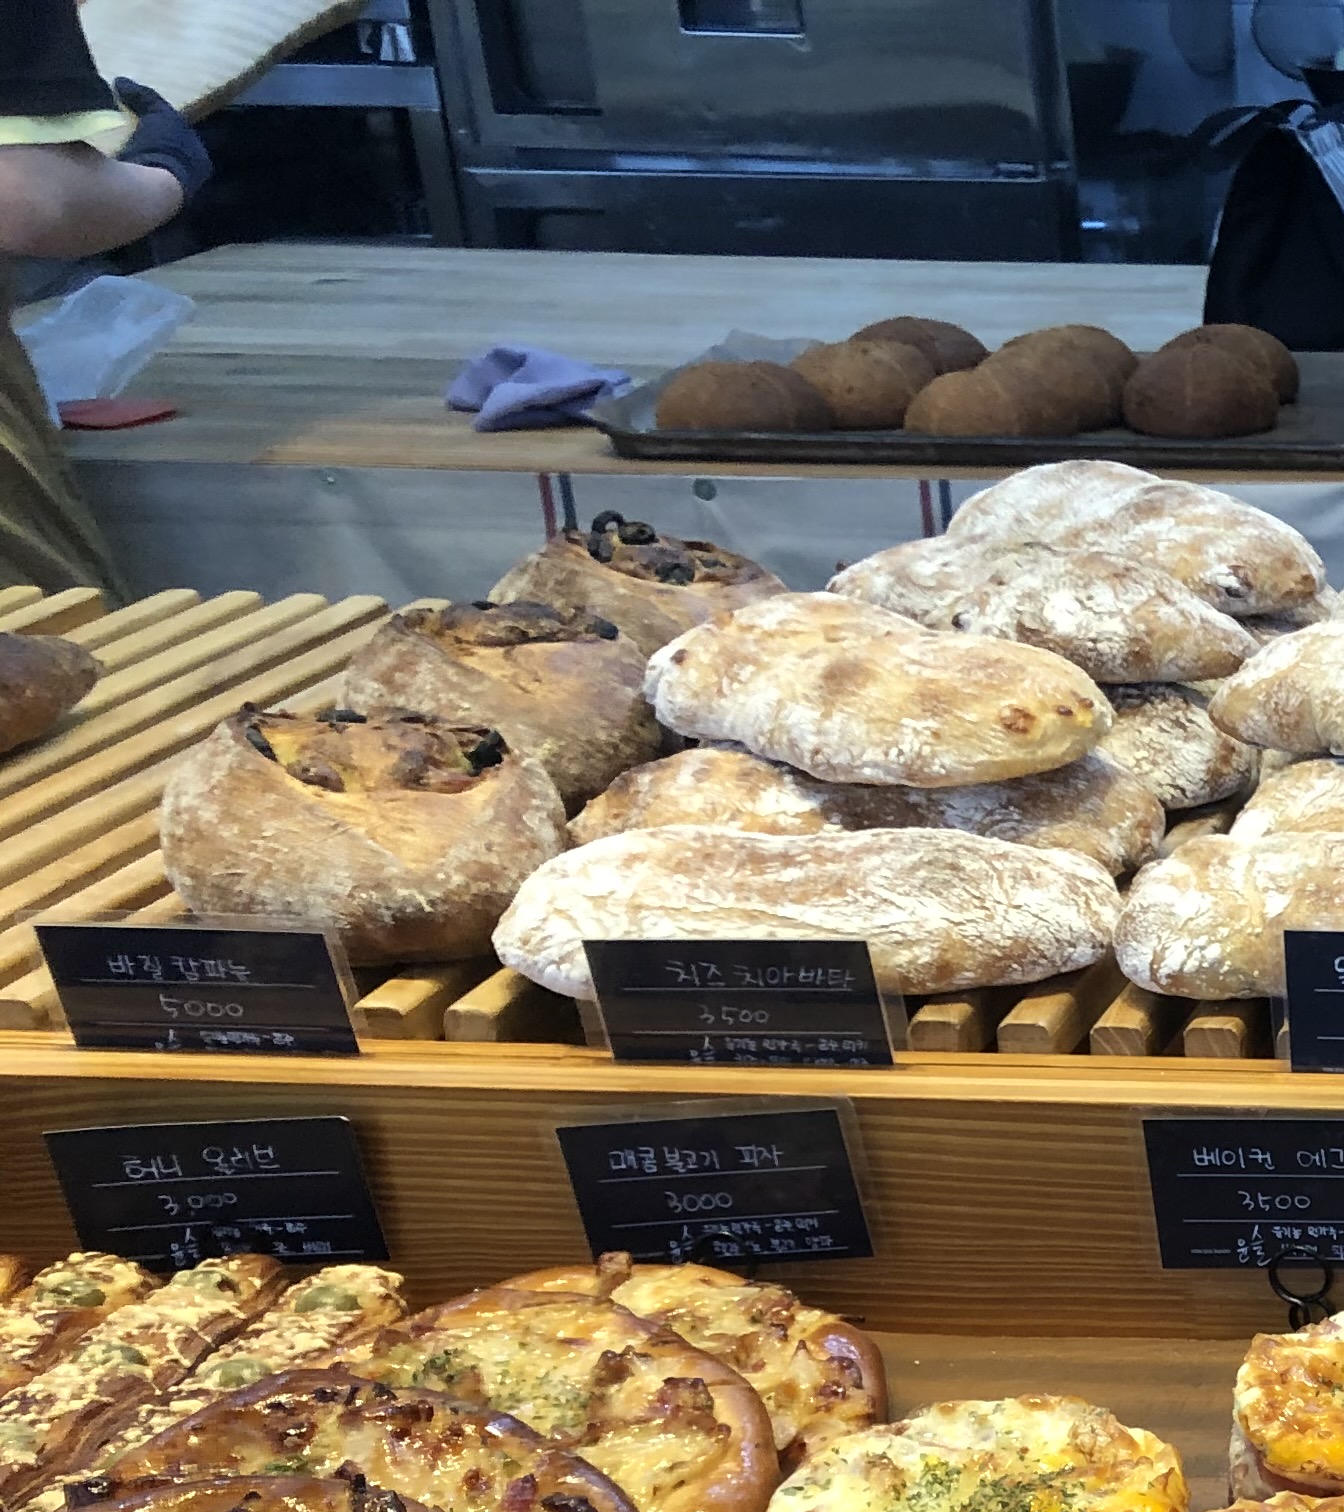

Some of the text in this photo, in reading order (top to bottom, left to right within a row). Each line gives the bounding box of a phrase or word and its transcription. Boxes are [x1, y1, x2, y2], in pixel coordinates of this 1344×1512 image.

[665, 960, 856, 989] 치즈 치아바타
[159, 993, 244, 1018] 5000
[699, 1004, 770, 1026] 3500
[735, 1144, 784, 1168] 피자
[1192, 1146, 1276, 1171] 베이컨
[664, 1191, 734, 1214] 3000
[1237, 1190, 1312, 1211] 3500
